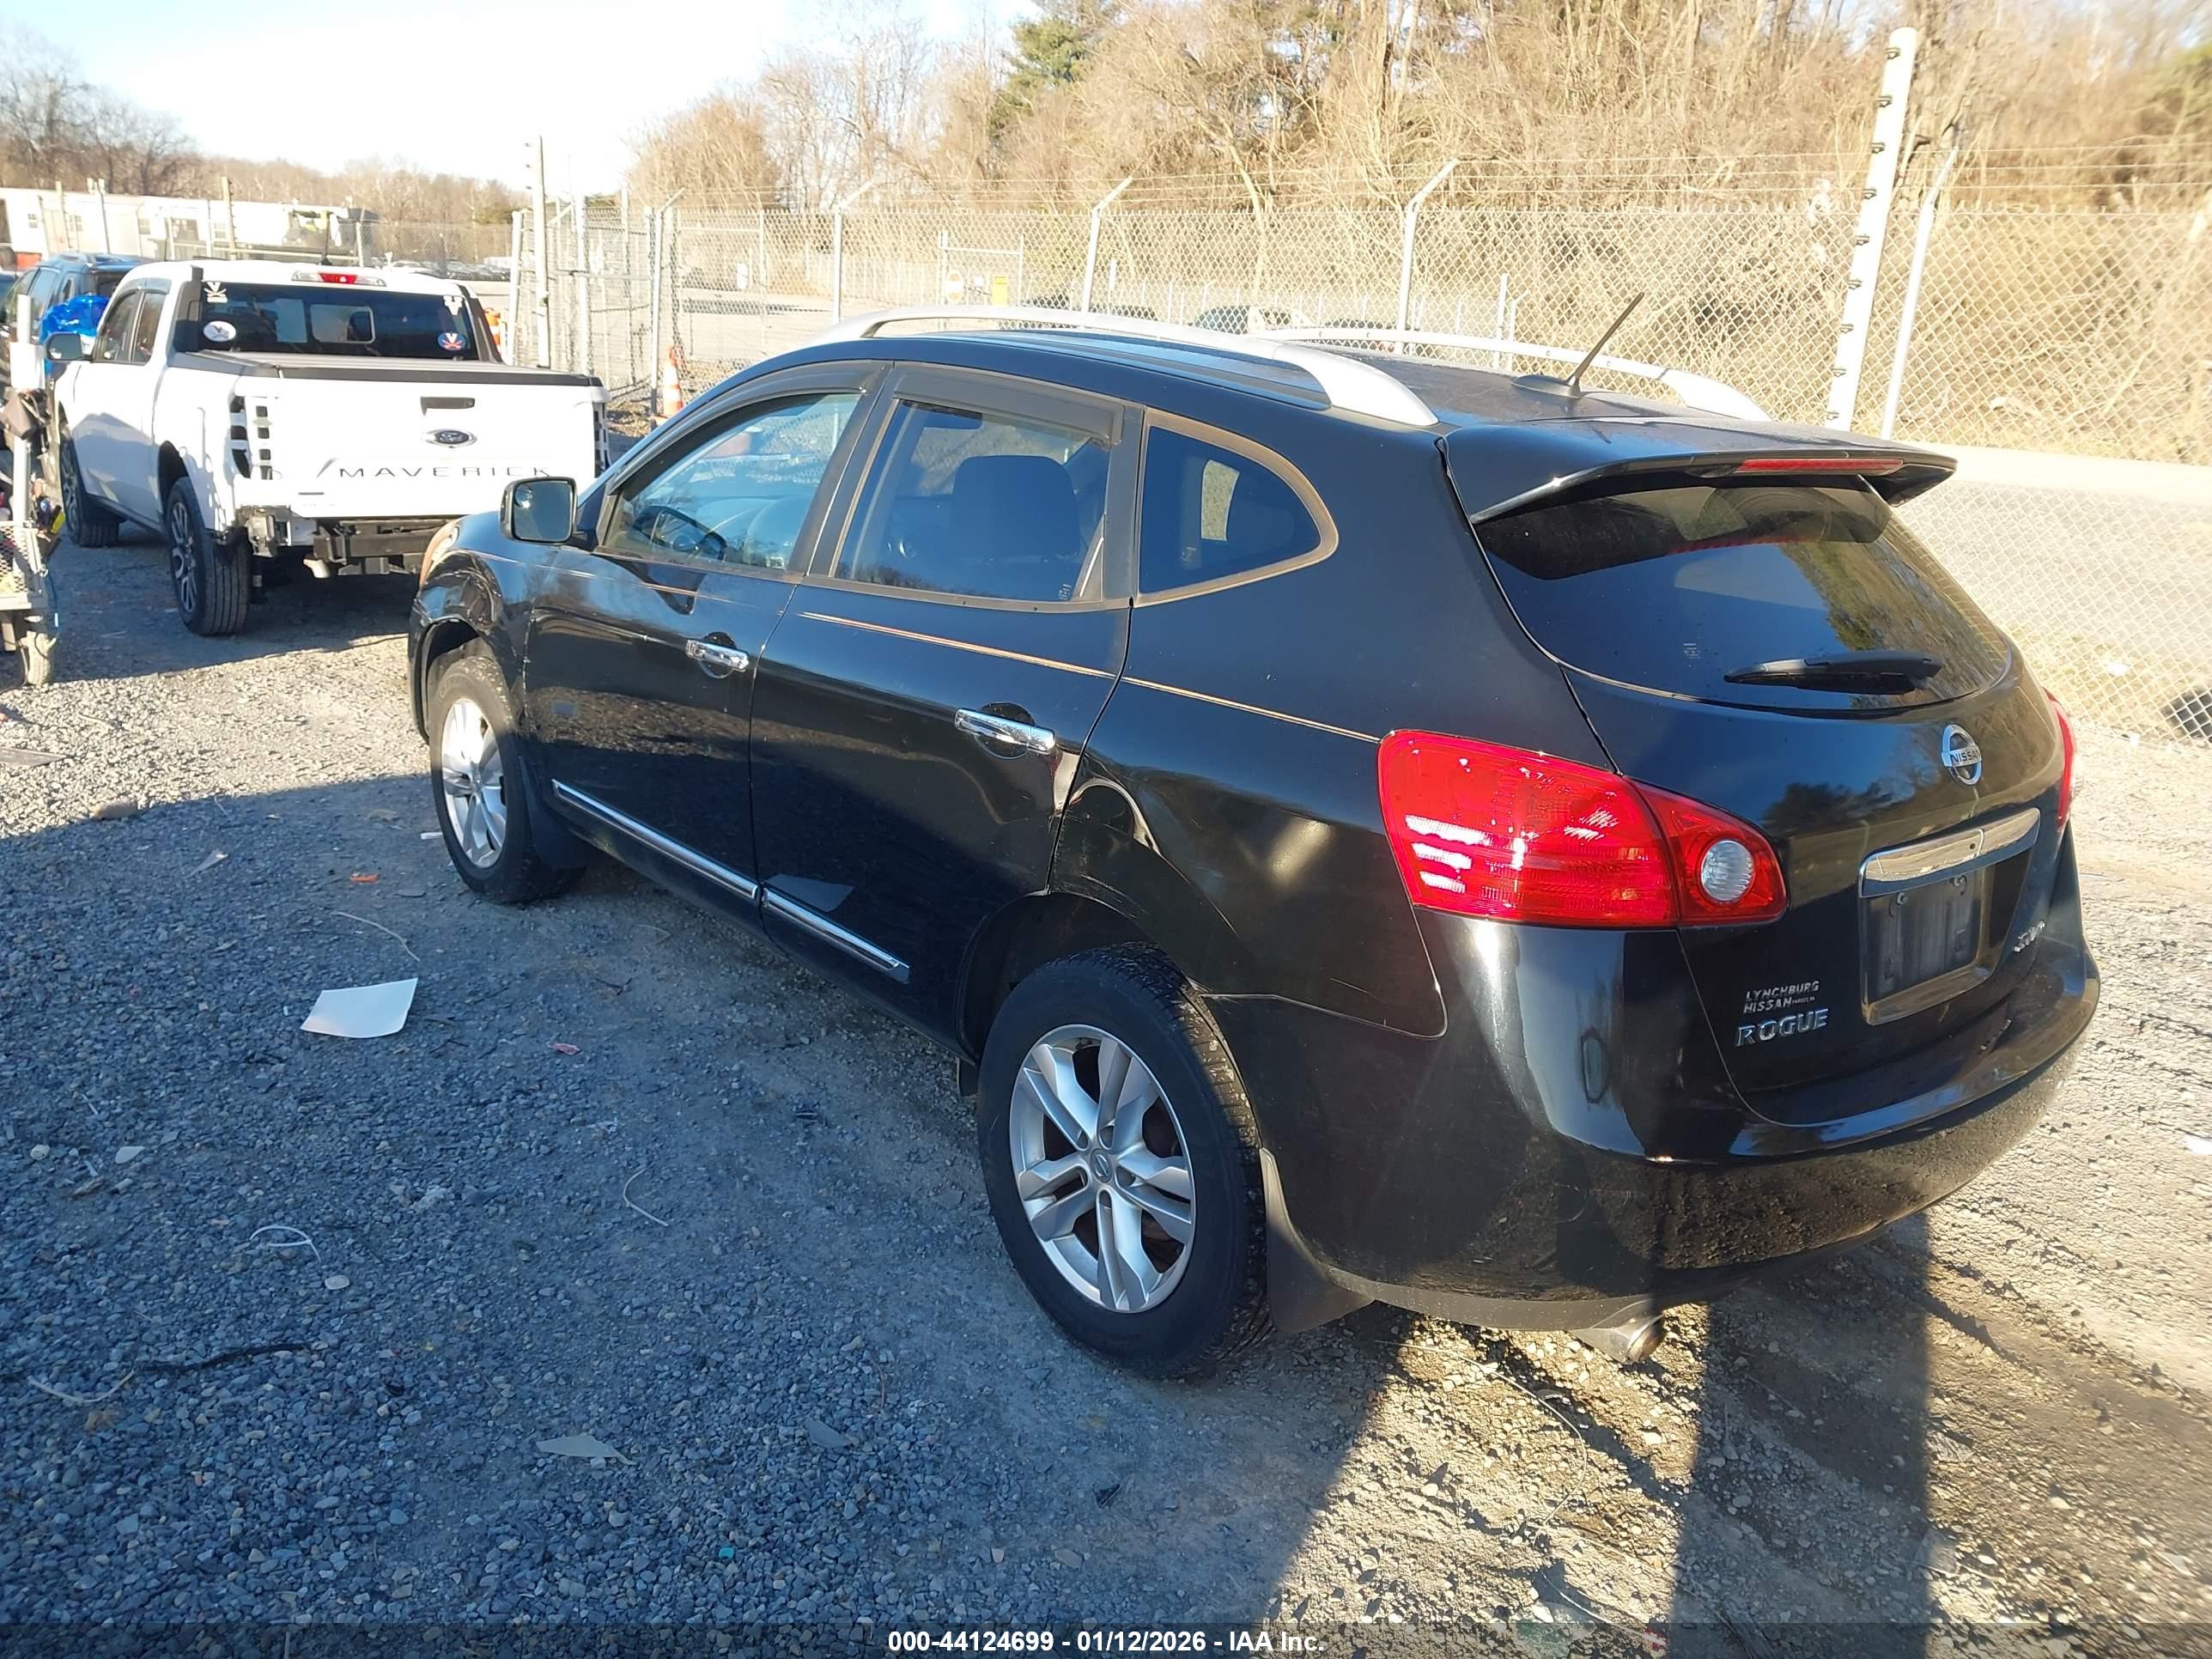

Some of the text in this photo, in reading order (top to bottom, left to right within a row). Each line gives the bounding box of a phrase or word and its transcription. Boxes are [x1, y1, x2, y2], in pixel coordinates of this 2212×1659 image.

[338, 466, 550, 478] MAVERICK
[1746, 980, 1820, 1001] LYNCHBURG
[1743, 997, 1793, 1014] NISSAN
[1735, 1007, 1830, 1048] ROGUE
